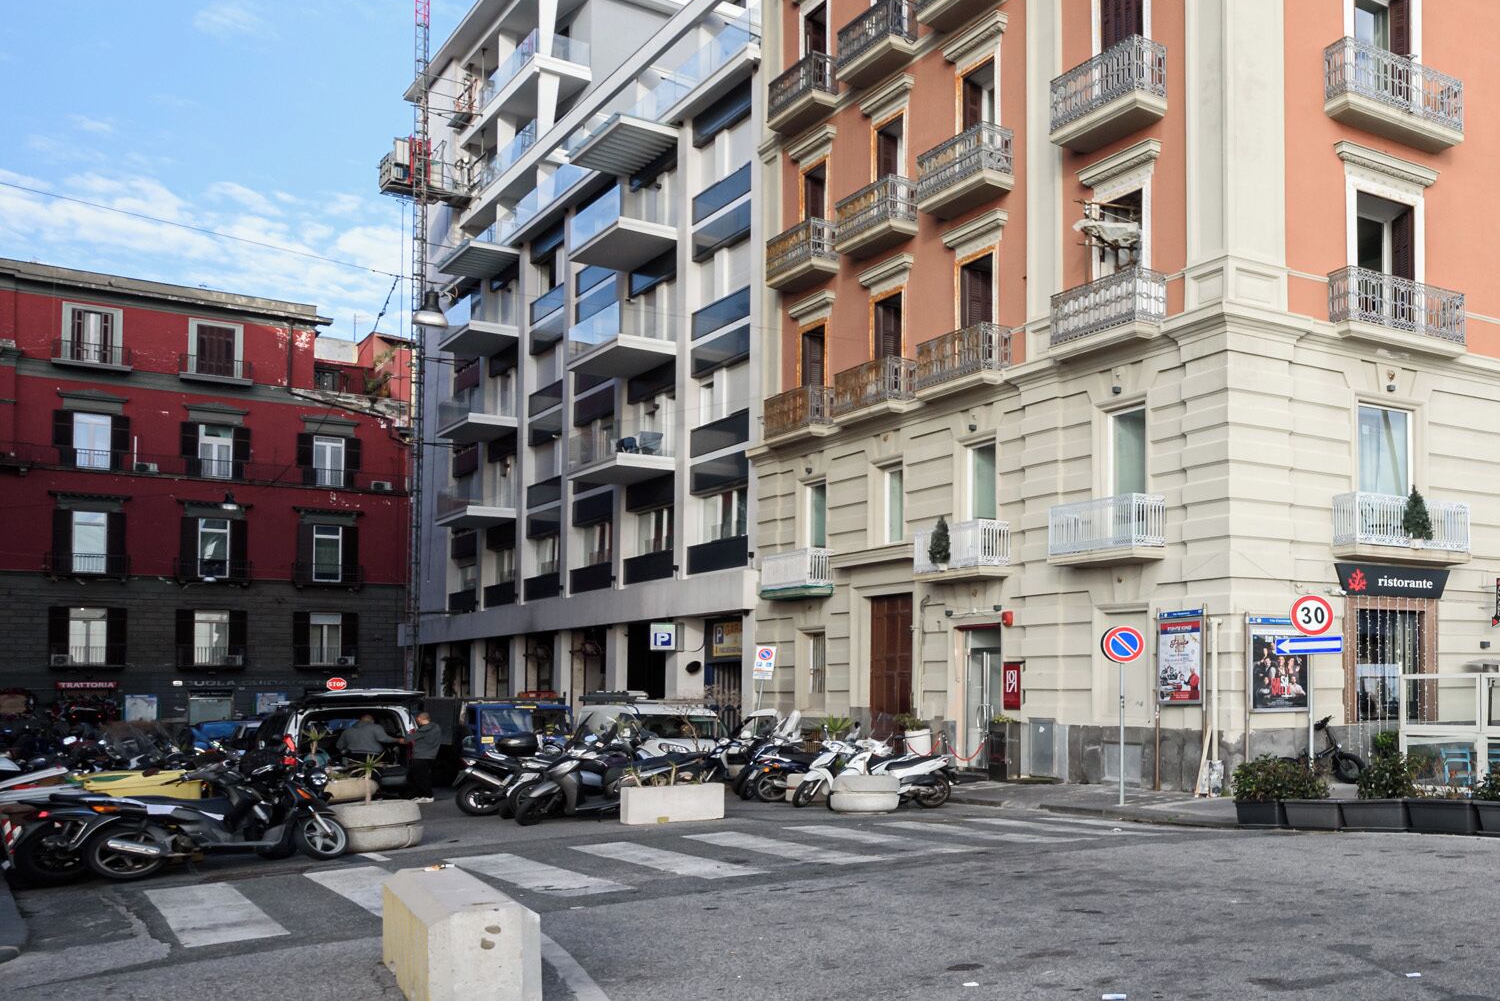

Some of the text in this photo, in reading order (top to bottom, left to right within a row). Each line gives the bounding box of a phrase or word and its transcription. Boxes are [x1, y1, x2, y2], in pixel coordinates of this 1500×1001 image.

[1378, 575, 1433, 589] ristorante
[1301, 606, 1325, 624] 30
[656, 633, 670, 646] P
[716, 627, 723, 644] P
